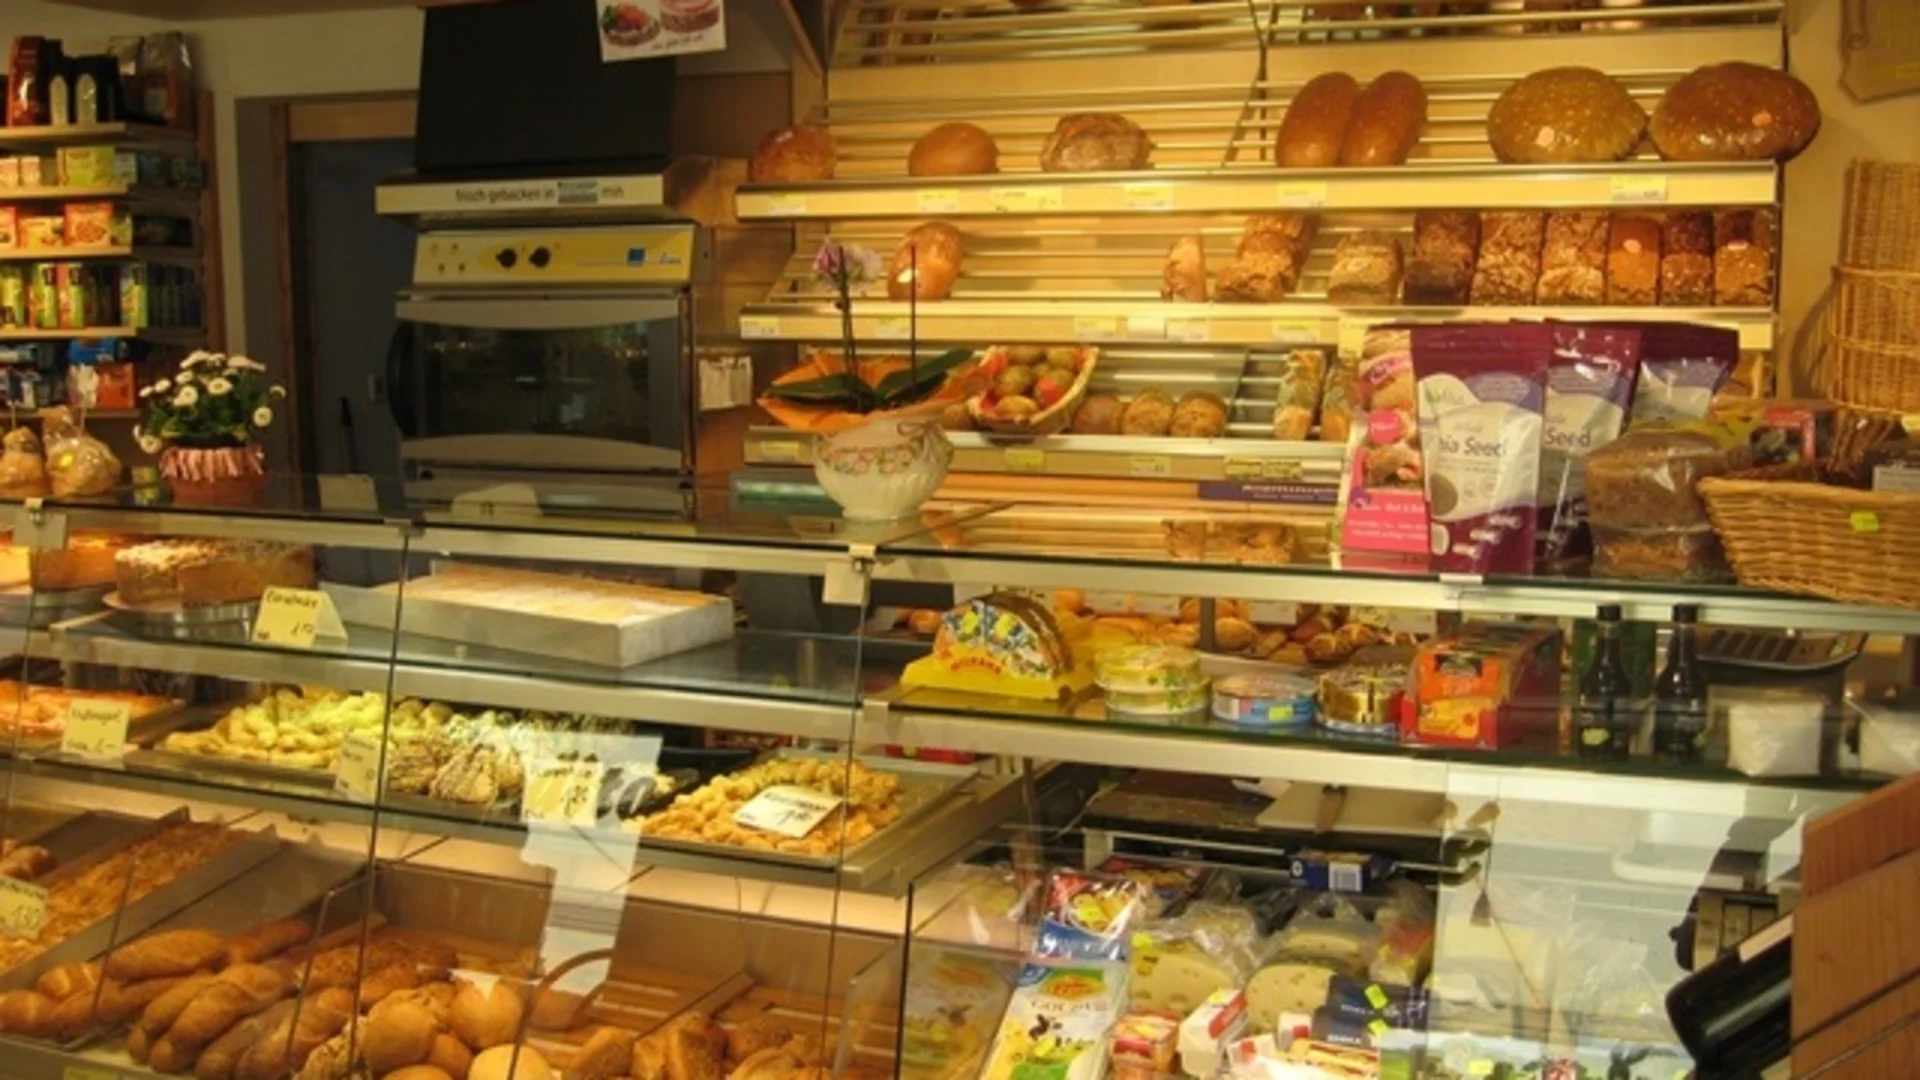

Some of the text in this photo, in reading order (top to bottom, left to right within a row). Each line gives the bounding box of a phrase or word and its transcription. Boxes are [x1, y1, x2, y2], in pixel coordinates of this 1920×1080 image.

[456, 187, 486, 202] frisch
[489, 186, 541, 204] gebacken
[544, 186, 555, 199] in
[1440, 435, 1459, 454] hia
[1546, 426, 1591, 447] Seed
